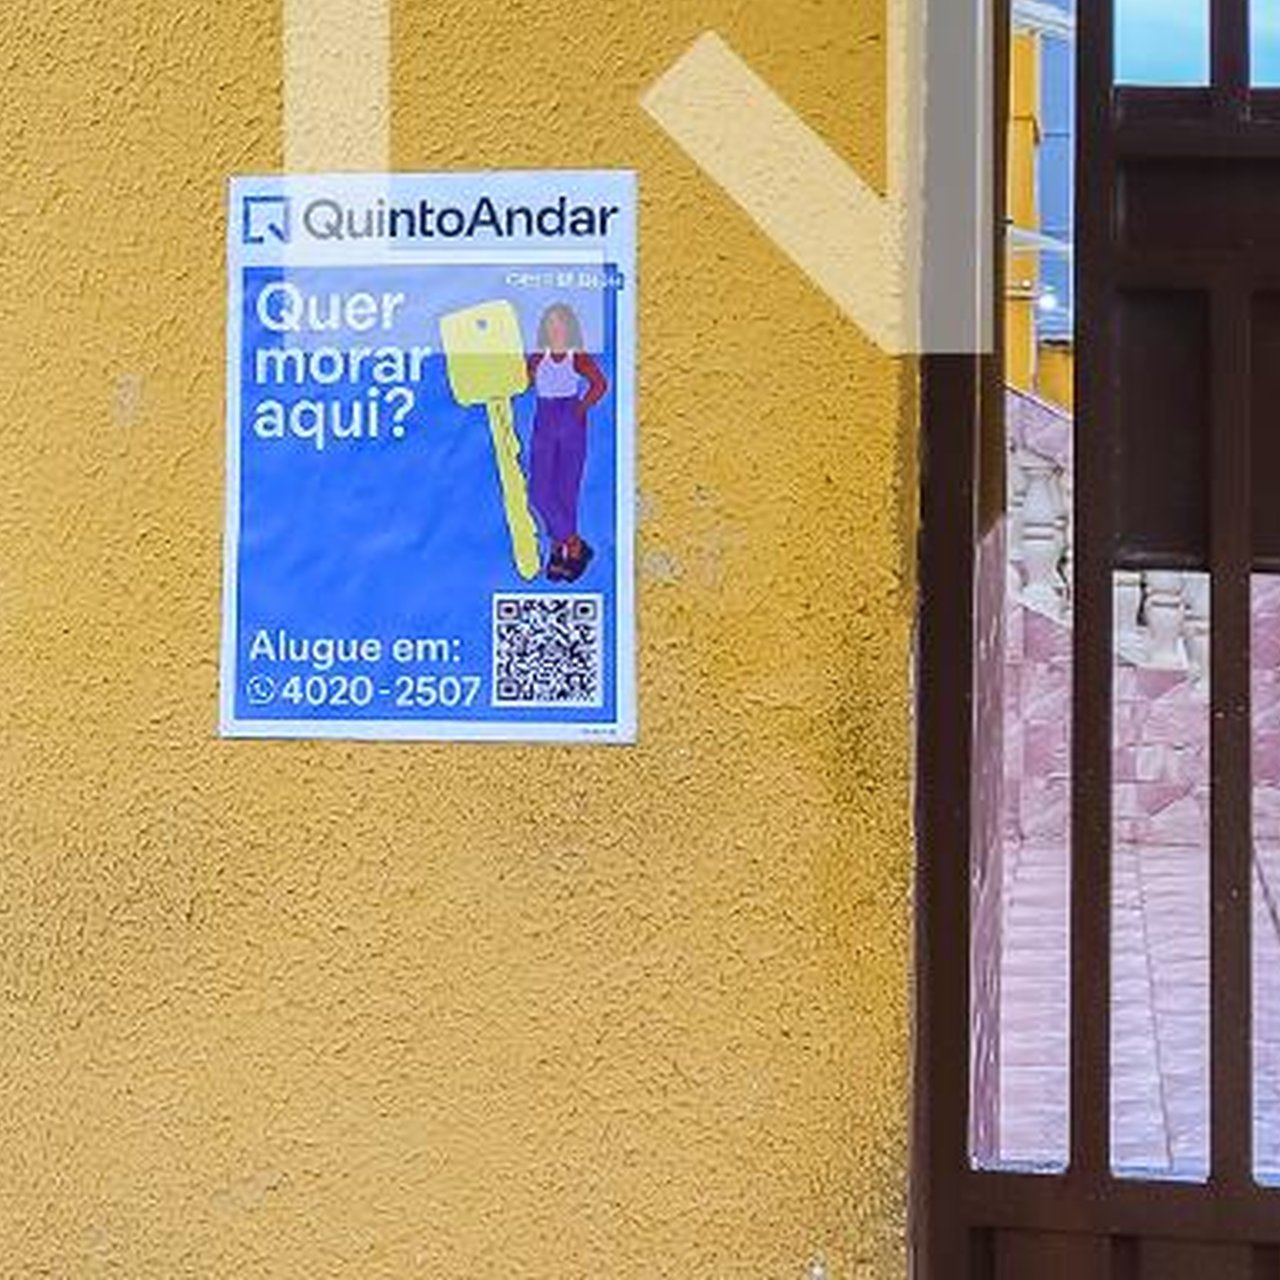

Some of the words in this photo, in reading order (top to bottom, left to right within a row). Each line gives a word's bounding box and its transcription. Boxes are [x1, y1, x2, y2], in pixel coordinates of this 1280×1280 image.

[303, 196, 619, 241] QuintoAndar
[256, 282, 406, 333] Quer
[255, 347, 434, 385] morar
[253, 385, 416, 451] aqui?
[249, 631, 382, 670] Alugue
[391, 639, 461, 662] em:
